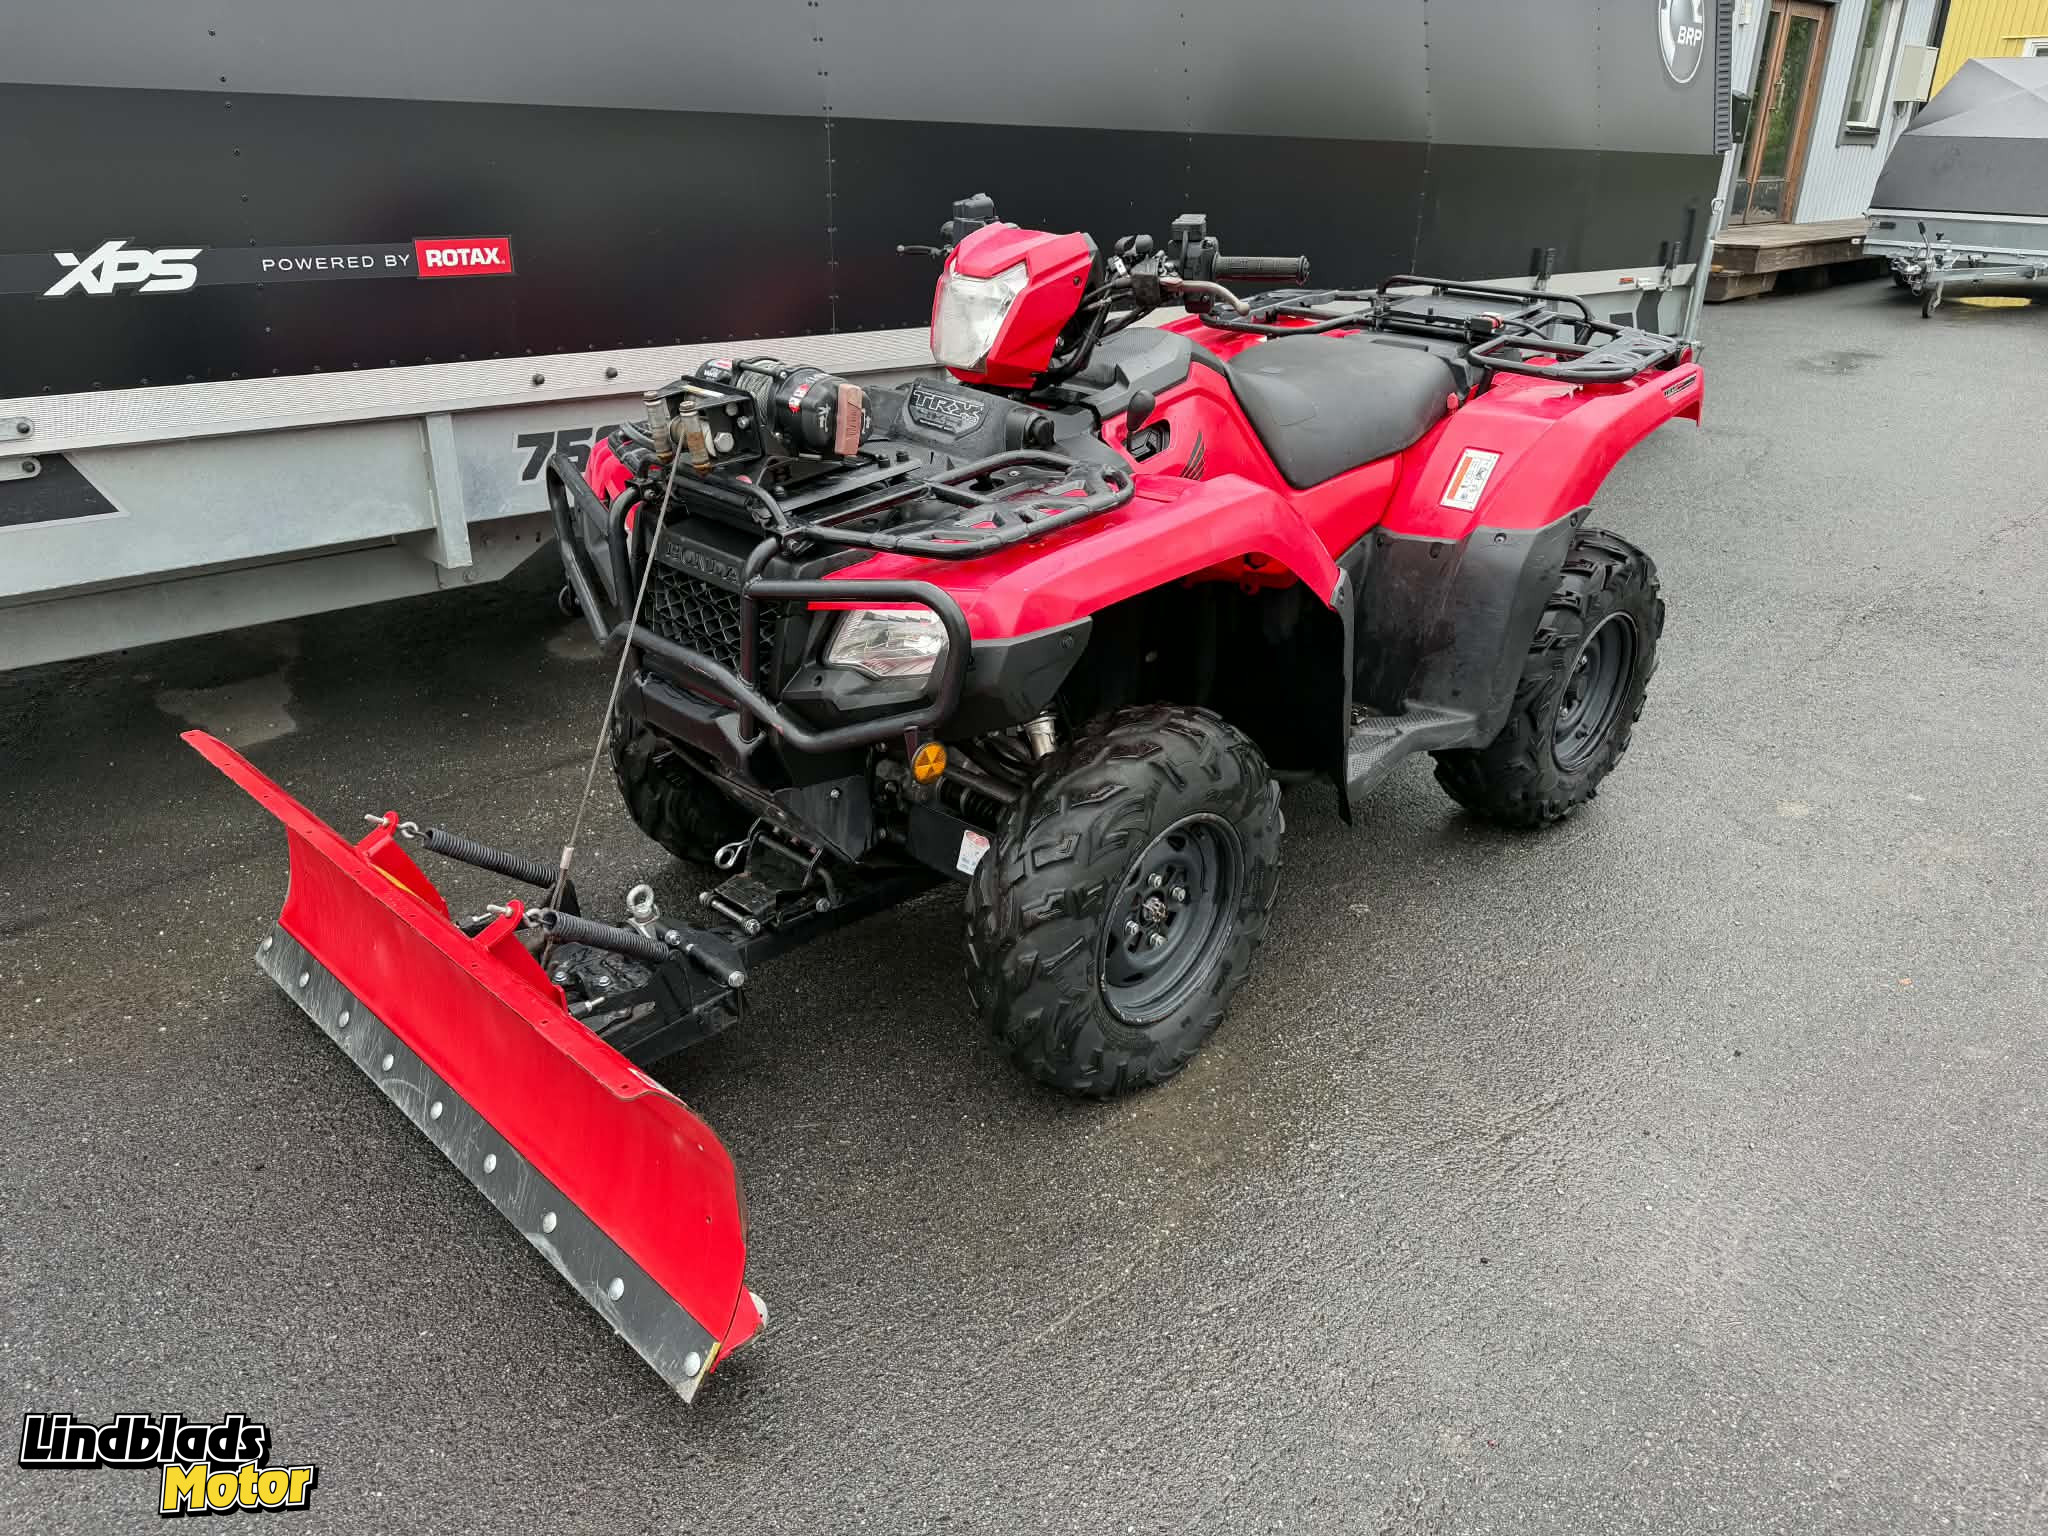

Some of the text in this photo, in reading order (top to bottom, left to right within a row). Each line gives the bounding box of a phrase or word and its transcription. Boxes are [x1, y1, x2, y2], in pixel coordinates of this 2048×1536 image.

[1677, 25, 1702, 46] BRP
[43, 240, 203, 296] XPS
[262, 247, 501, 272] POWERED BY ROTAX
[913, 390, 984, 420] TRX
